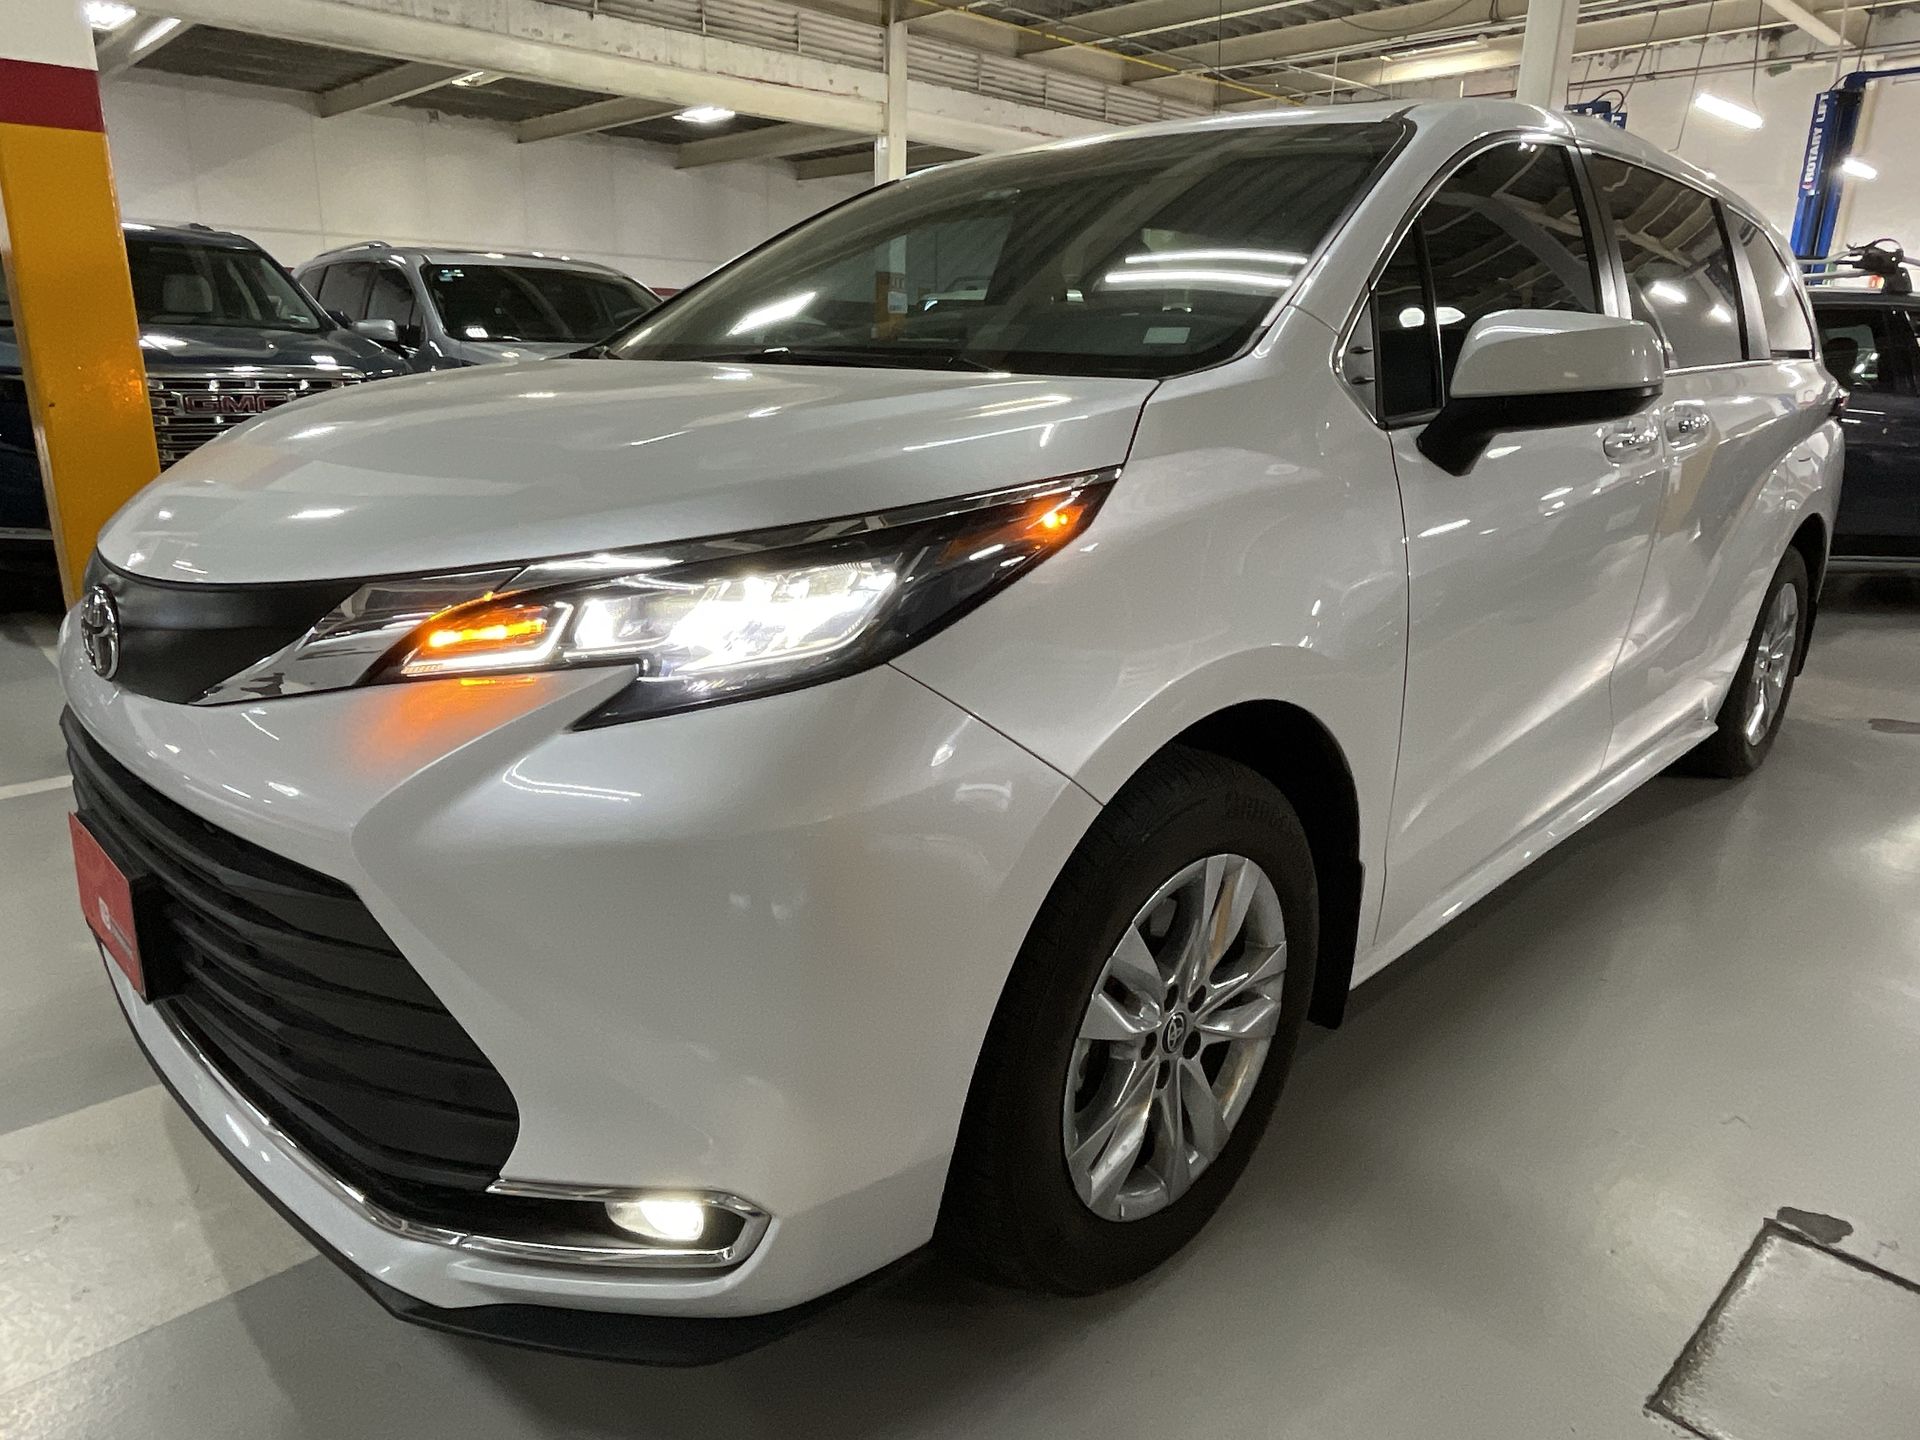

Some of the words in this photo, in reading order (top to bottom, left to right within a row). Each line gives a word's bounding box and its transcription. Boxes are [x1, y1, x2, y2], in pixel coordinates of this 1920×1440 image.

[1804, 127, 1822, 182] ROTARY
[1815, 93, 1829, 123] LIFT
[185, 395, 289, 413] GMC
